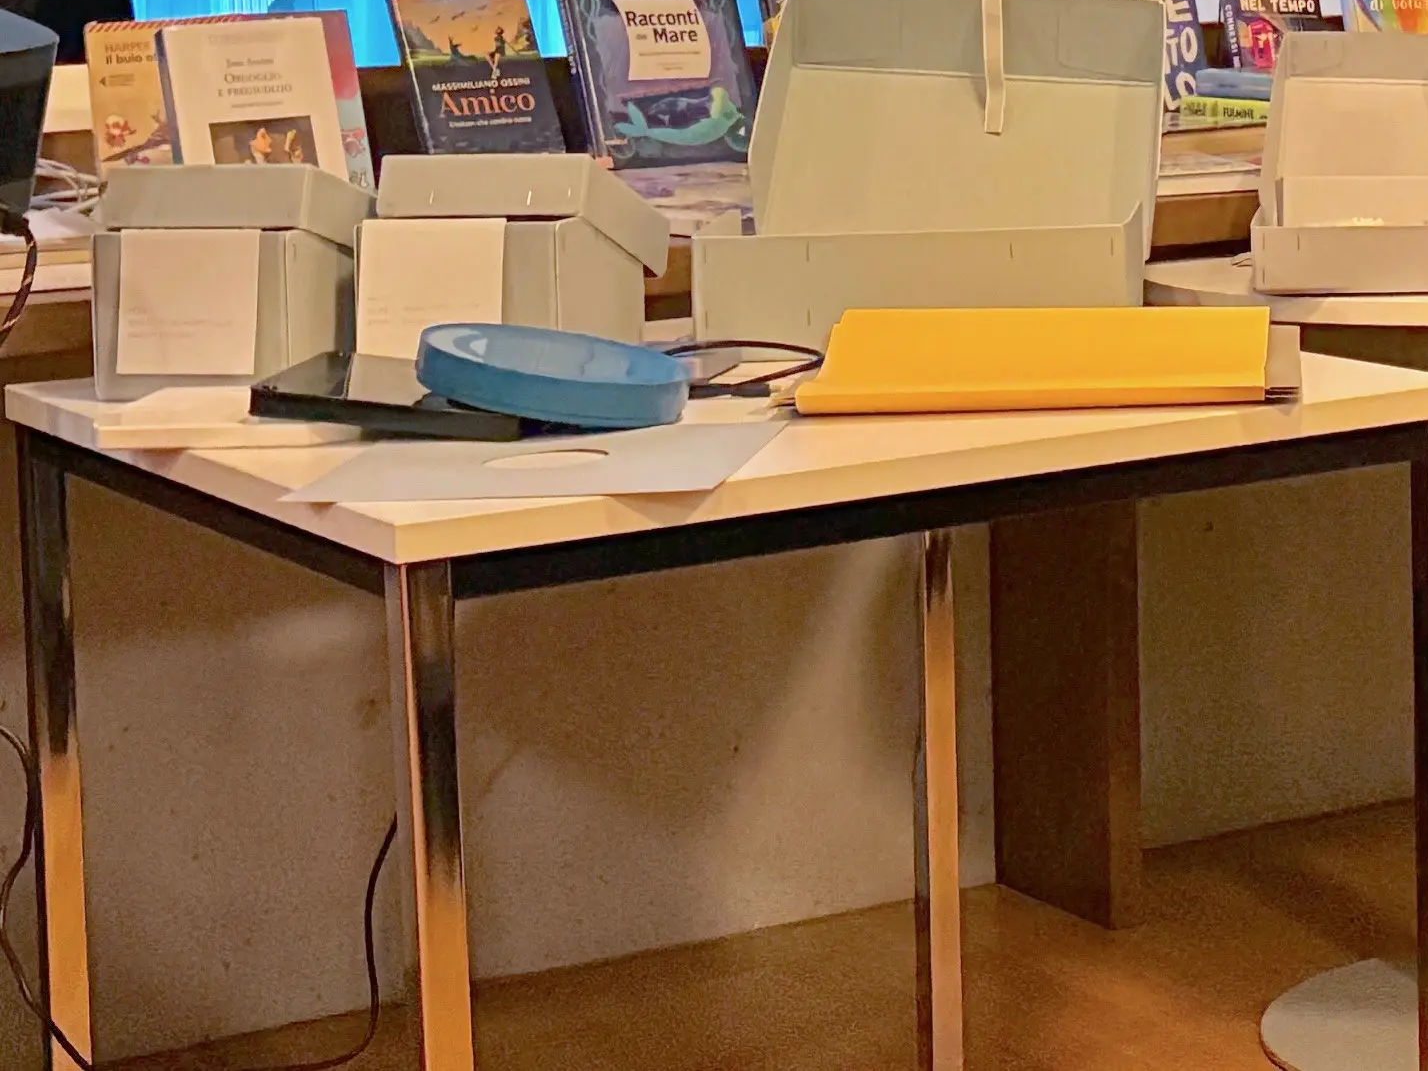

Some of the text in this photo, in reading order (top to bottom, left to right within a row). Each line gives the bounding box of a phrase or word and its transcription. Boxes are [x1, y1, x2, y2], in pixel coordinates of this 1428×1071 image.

[625, 9, 700, 28] Racconti
[653, 28, 698, 44] Mare
[1225, 4, 1239, 54] CONNESSI
[116, 53, 143, 64] buio
[431, 79, 499, 92] MASSIMILIANO
[439, 89, 536, 119] Amico
